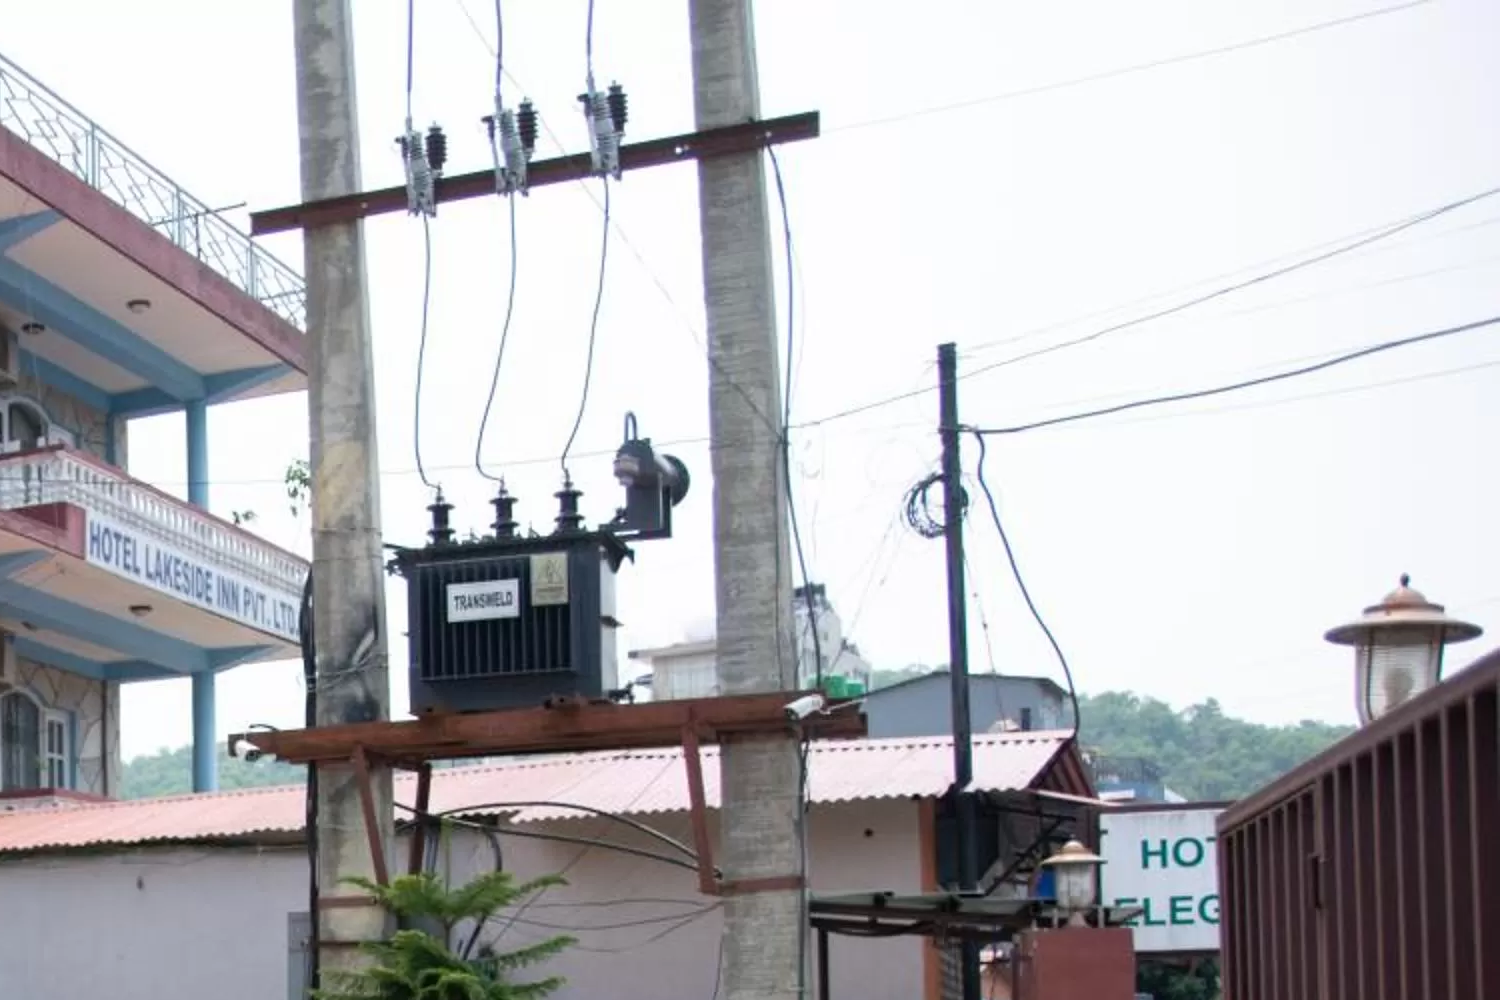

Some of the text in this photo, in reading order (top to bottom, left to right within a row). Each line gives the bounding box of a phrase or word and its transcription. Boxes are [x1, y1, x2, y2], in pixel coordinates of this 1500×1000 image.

[89, 519, 141, 576] HOTEL
[145, 544, 213, 603] LAKESIDE
[216, 574, 240, 616] INN
[1141, 837, 1216, 869] HO
